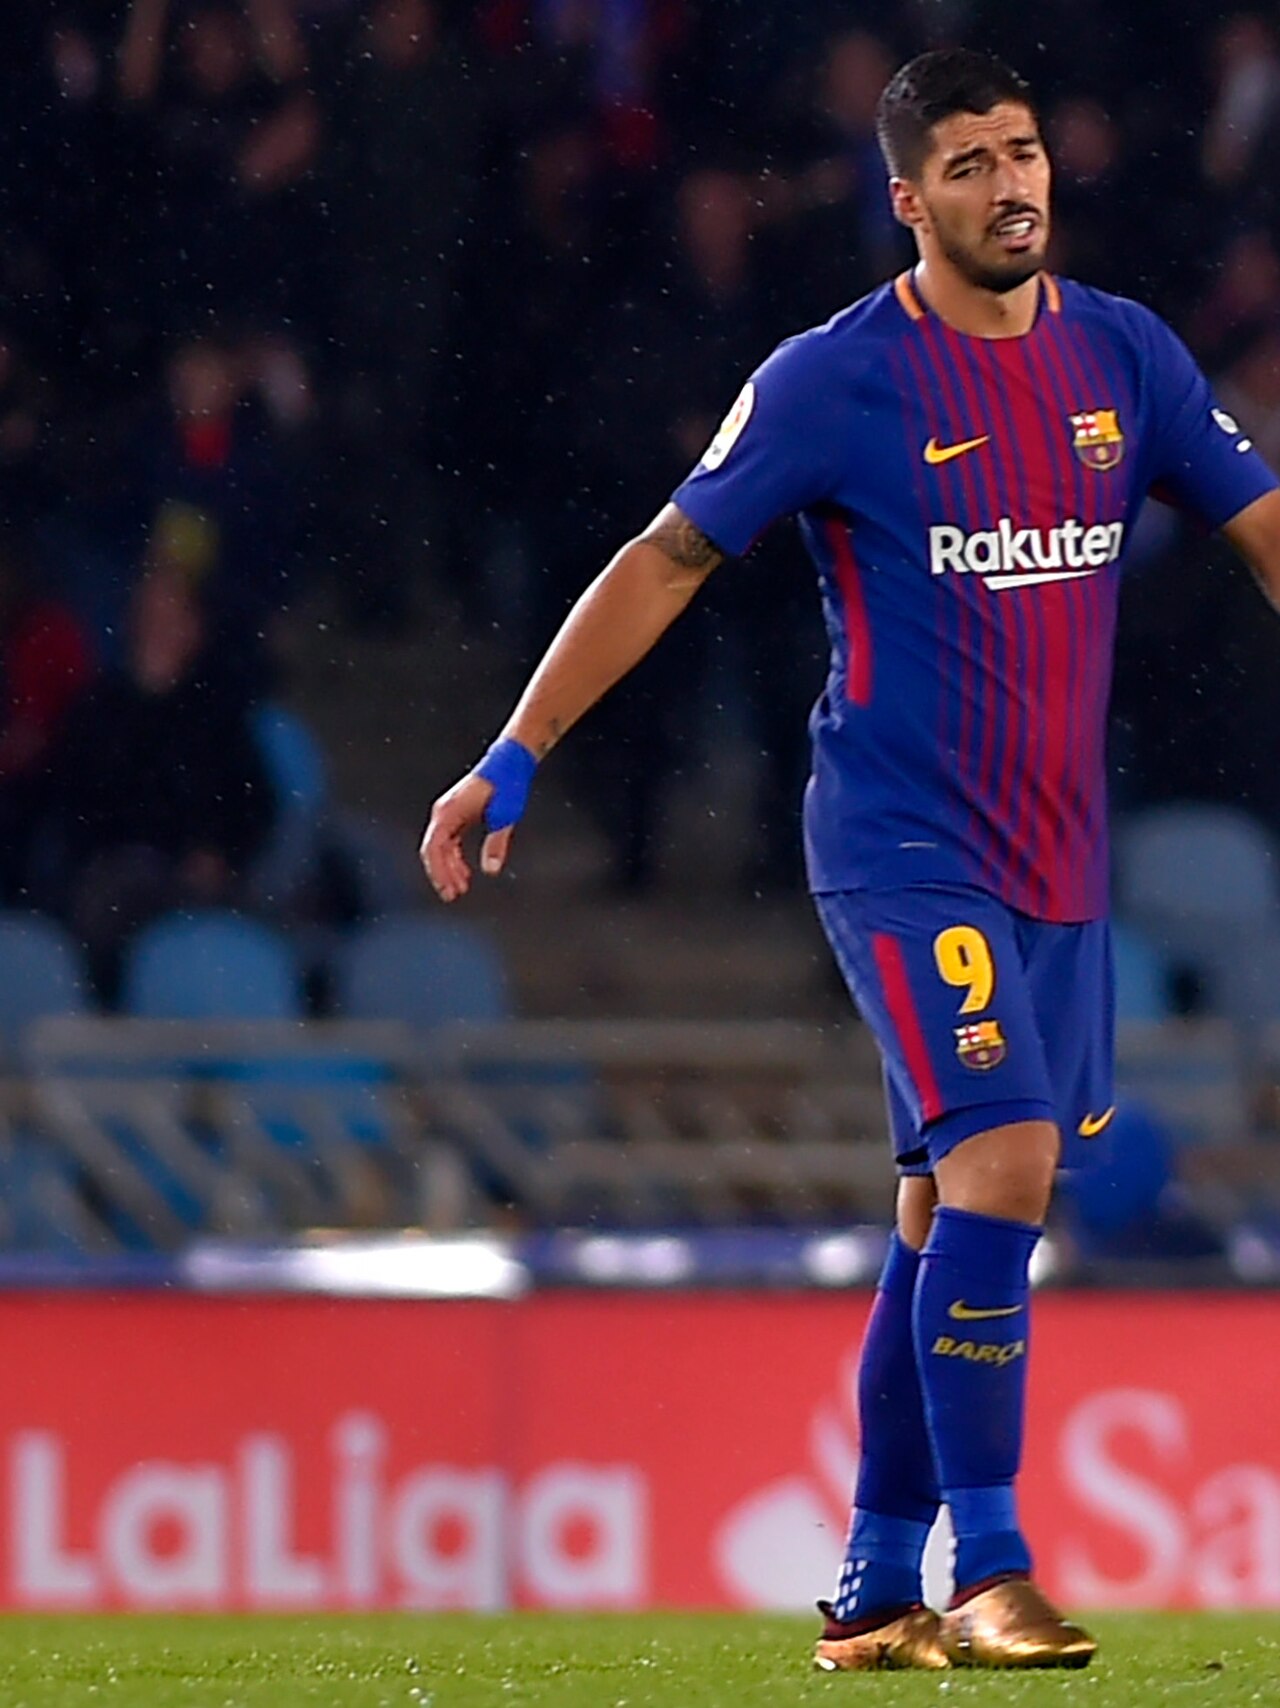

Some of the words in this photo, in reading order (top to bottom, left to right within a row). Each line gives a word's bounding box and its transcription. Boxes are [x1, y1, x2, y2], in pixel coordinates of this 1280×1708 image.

[929, 518, 1124, 574] Rakuten
[933, 925, 994, 1015] 9
[12, 1409, 647, 1613] LaLiga
